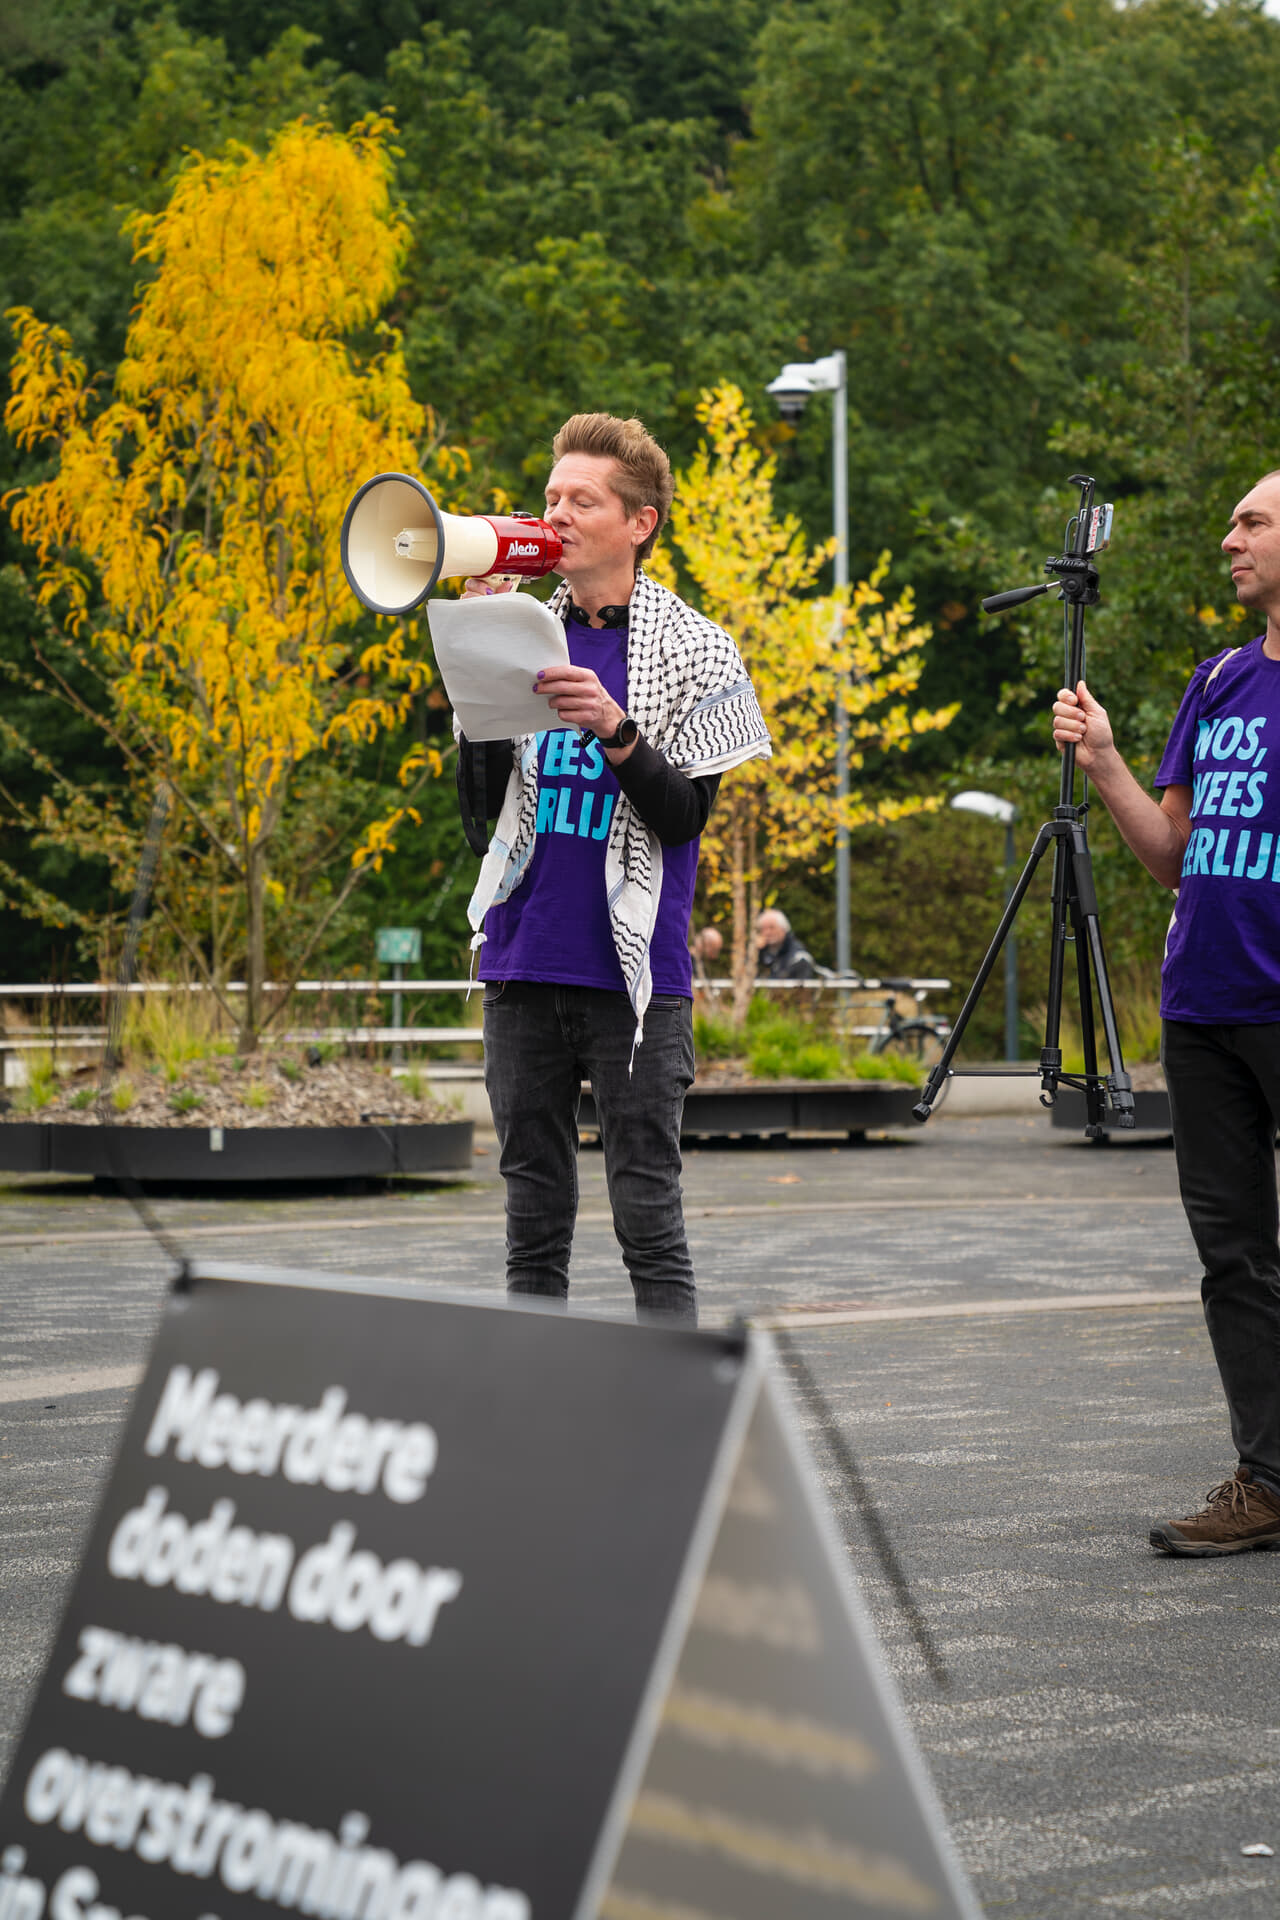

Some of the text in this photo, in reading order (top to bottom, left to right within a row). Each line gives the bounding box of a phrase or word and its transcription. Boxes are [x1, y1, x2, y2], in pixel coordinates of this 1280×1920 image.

[505, 539, 540, 561] Alecto
[535, 729, 604, 780] EES
[1193, 716, 1268, 768] NOS,
[535, 786, 615, 840] RLIJ
[144, 1364, 438, 1504] Meerdere
[107, 1485, 463, 1647] doden door
[64, 1625, 246, 1738] zware
